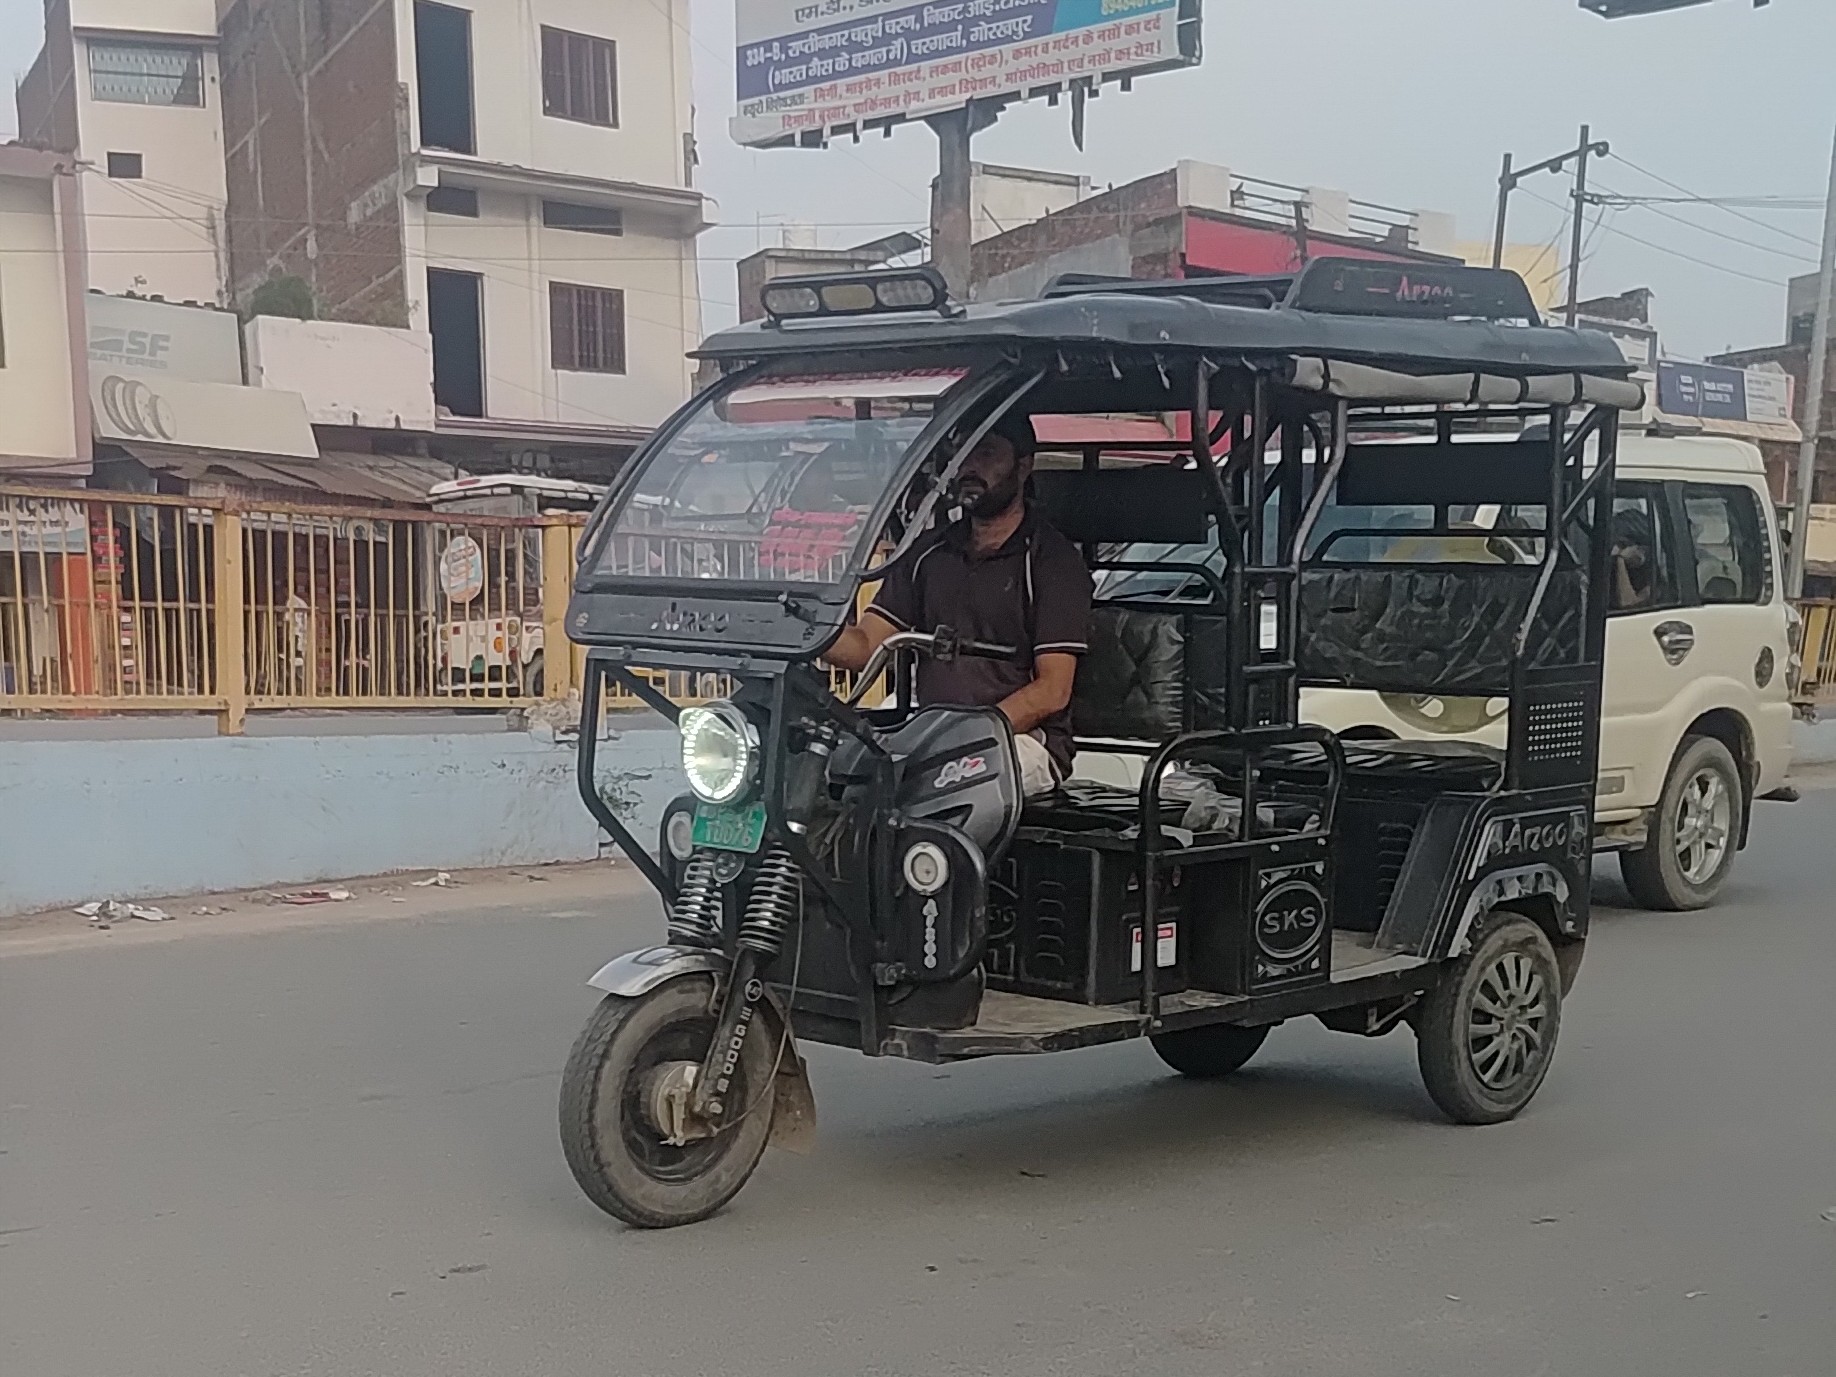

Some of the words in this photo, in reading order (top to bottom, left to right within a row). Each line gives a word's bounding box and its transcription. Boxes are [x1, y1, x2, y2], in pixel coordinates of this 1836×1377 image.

[834, 51, 850, 71] के
[969, 15, 1034, 41] गोरखपुर
[1081, 29, 1095, 45] के
[1123, 22, 1142, 36] का
[1143, 13, 1162, 32] दर्द
[1114, 47, 1131, 61] का
[126, 329, 171, 358] SF
[1262, 905, 1317, 934] SKS
